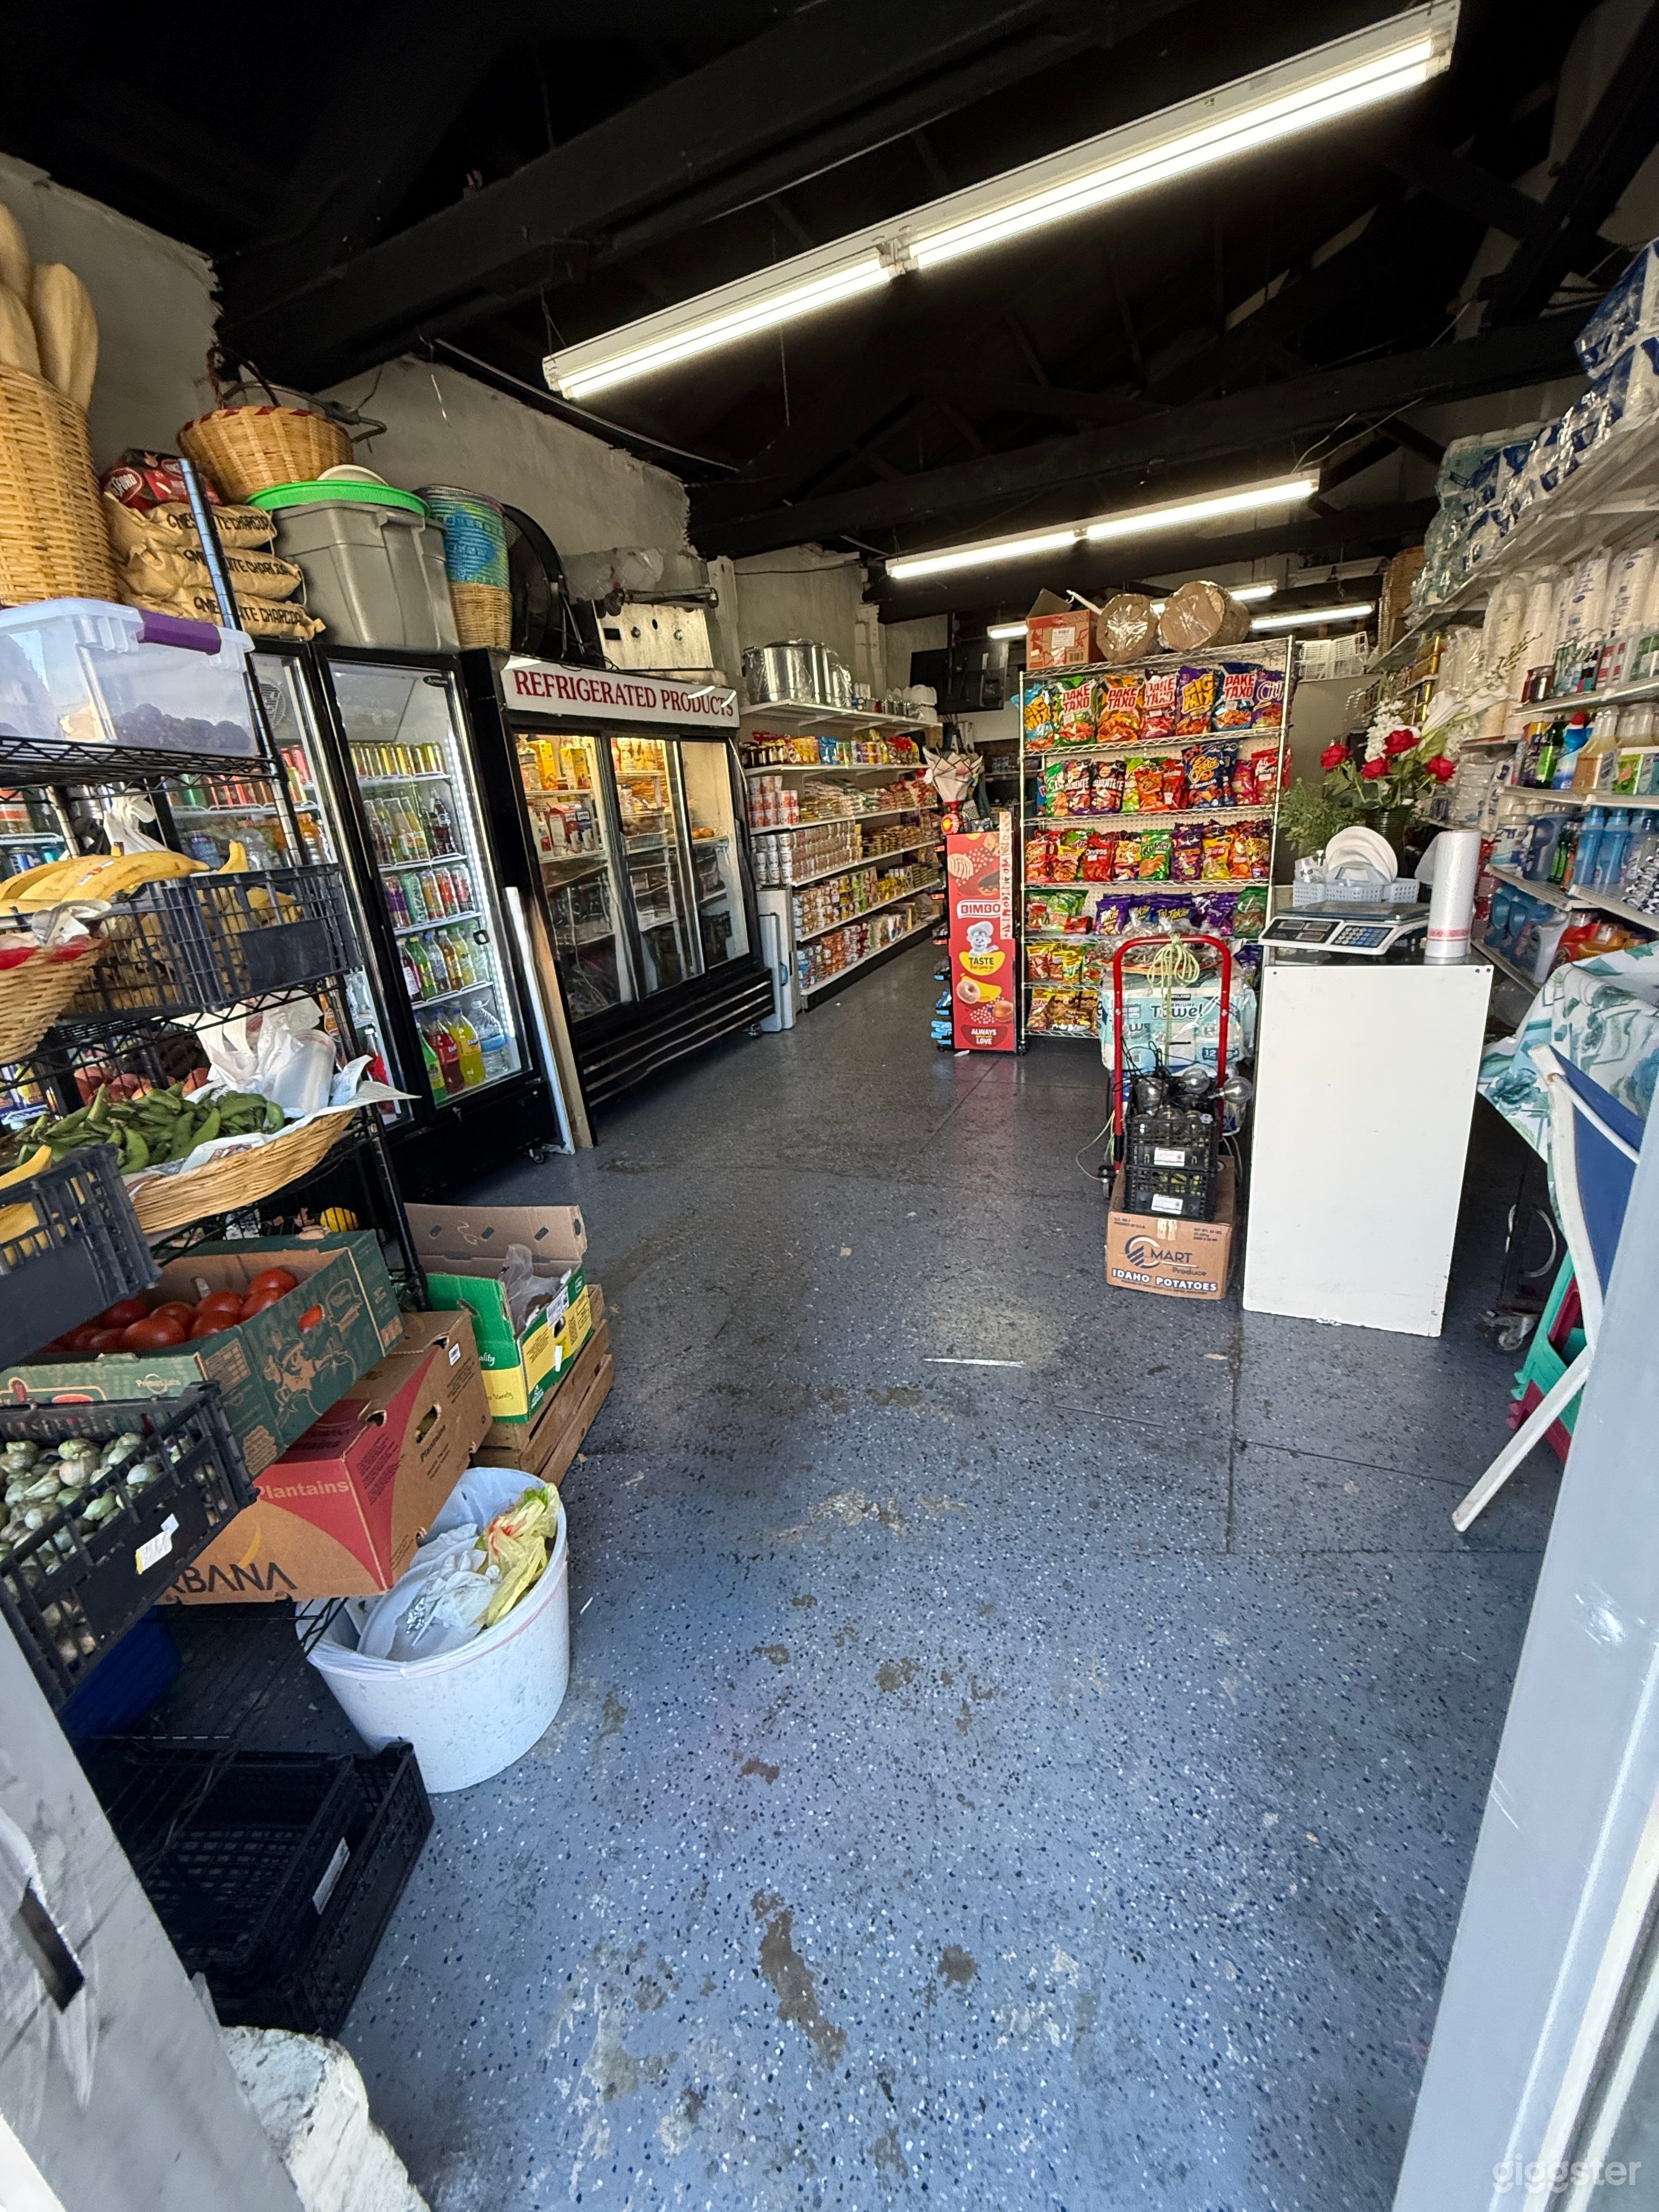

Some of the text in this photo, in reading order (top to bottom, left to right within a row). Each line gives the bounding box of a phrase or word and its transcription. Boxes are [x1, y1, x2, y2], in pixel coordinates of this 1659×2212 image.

[513, 669, 733, 717] REFRIGERATED PRODUCTS
[1183, 692, 1214, 712] MIX
[960, 903, 1001, 914] BIMBO
[968, 957, 994, 965] TASTE
[1150, 1248, 1193, 1264] MART
[1112, 1268, 1150, 1283] IDAHO
[1156, 1277, 1218, 1292] POTATOES
[1172, 1267, 1207, 1277] Produce
